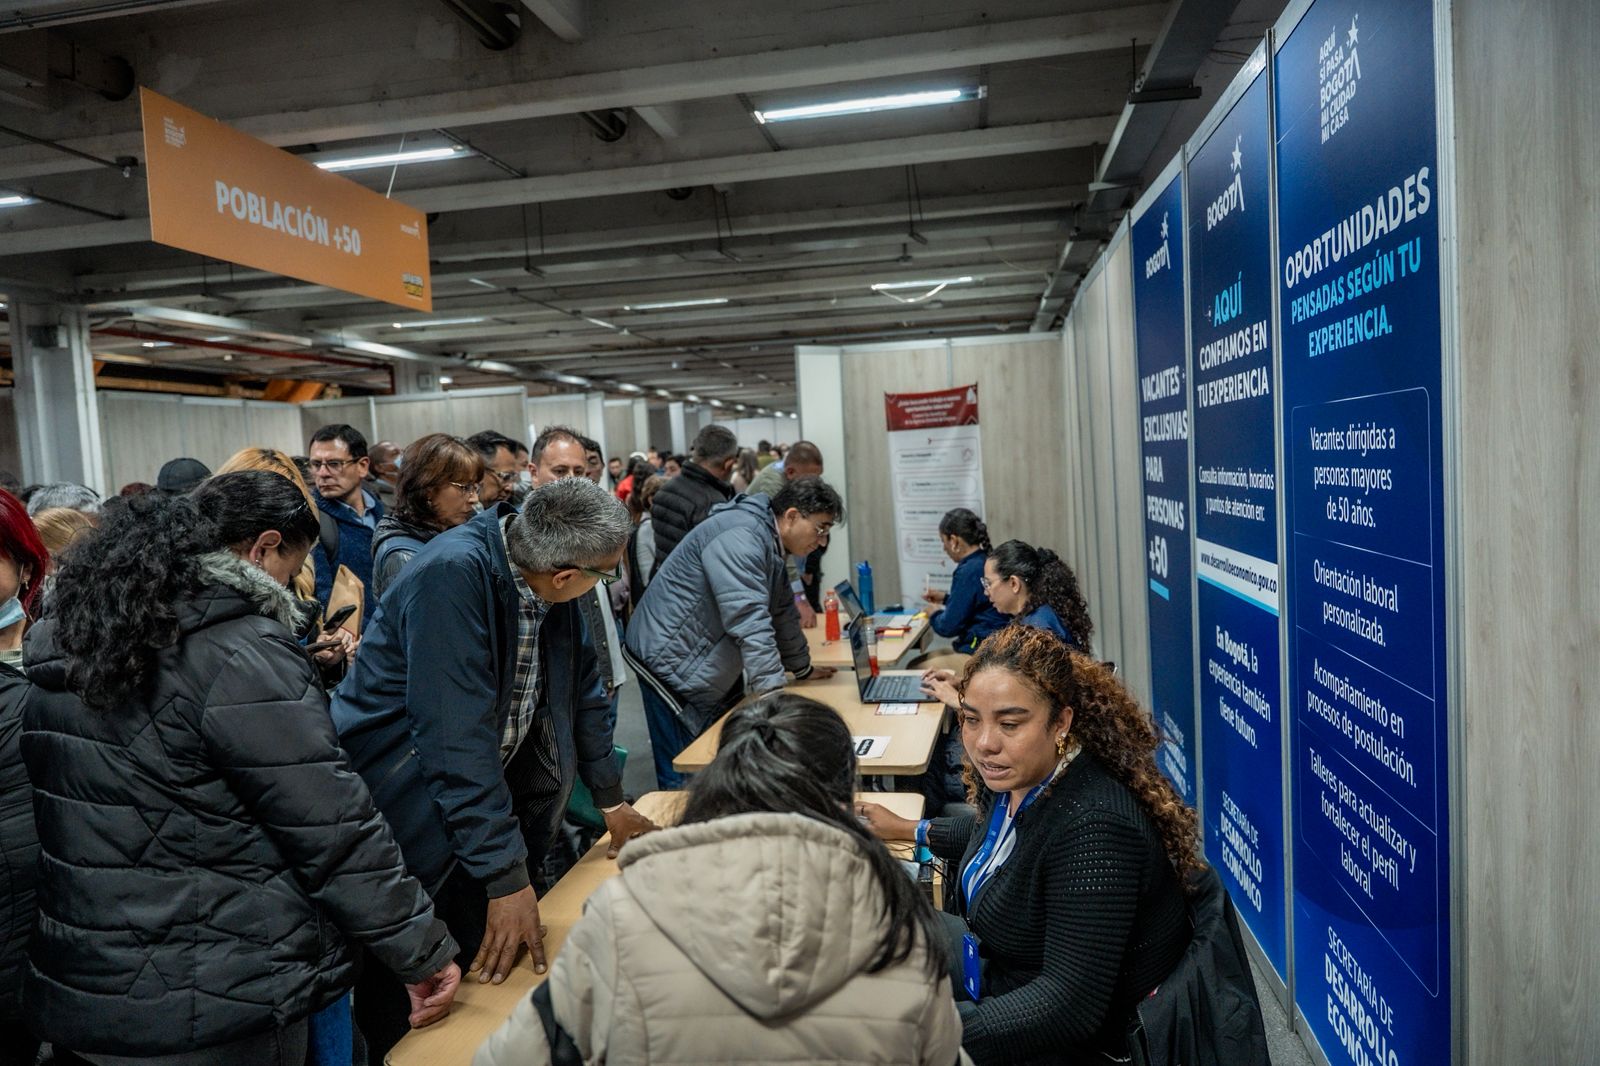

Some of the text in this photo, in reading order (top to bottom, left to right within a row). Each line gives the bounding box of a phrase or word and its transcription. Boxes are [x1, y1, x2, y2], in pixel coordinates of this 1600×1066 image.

[1319, 25, 1336, 64] AQUÍ
[1319, 45, 1344, 85] SÍ PASA
[1321, 80, 1356, 128] MI CIUDAD
[1321, 106, 1349, 145] MI CASA
[215, 180, 361, 256] POBLACIÓN +50
[1285, 166, 1431, 289] OPORTUNIDADES
[1213, 271, 1242, 327] AQUÍ
[1292, 236, 1421, 325] PENSADAS SEGÚN TU
[1199, 320, 1267, 371] CONFIAMOS EN
[1308, 304, 1393, 357] EXPERIENCIA.
[1142, 365, 1179, 402] VACANTES
[1197, 366, 1269, 408] TU EXPERIENCIA
[1144, 409, 1188, 442] EXCLUSIVAS
[1310, 422, 1396, 457] Vacantes dirigidas a
[1145, 456, 1164, 483] PARA
[1199, 465, 1275, 490] Consulta información, horarios
[1314, 466, 1393, 496] personas mayores
[1147, 494, 1184, 531] PERSONAS
[1209, 496, 1224, 515] puntos
[1224, 496, 1231, 515] de
[1232, 499, 1255, 520] atención
[1326, 496, 1376, 528] de 50 años.
[1149, 535, 1168, 579] +50
[1313, 559, 1399, 613] Orientación laboral
[1216, 625, 1258, 674] En Bogotá, la
[1323, 601, 1386, 647] personalizada.
[1208, 658, 1271, 723] experiencia también
[1313, 657, 1405, 739] Acompañamiento en
[1219, 696, 1258, 749] tiene futuro.
[1307, 690, 1417, 788] procesos de postulación.
[1222, 790, 1259, 850] SECRETARÍA DE
[1309, 747, 1417, 873] Talleres para actualizar y
[1220, 812, 1262, 883] DESARROLLO
[1321, 791, 1399, 891] fortalecer el perfil
[1222, 841, 1262, 913] ECONÓMICO
[1341, 842, 1374, 900] laboral.
[1327, 925, 1394, 1036] SECRETARÍA DE
